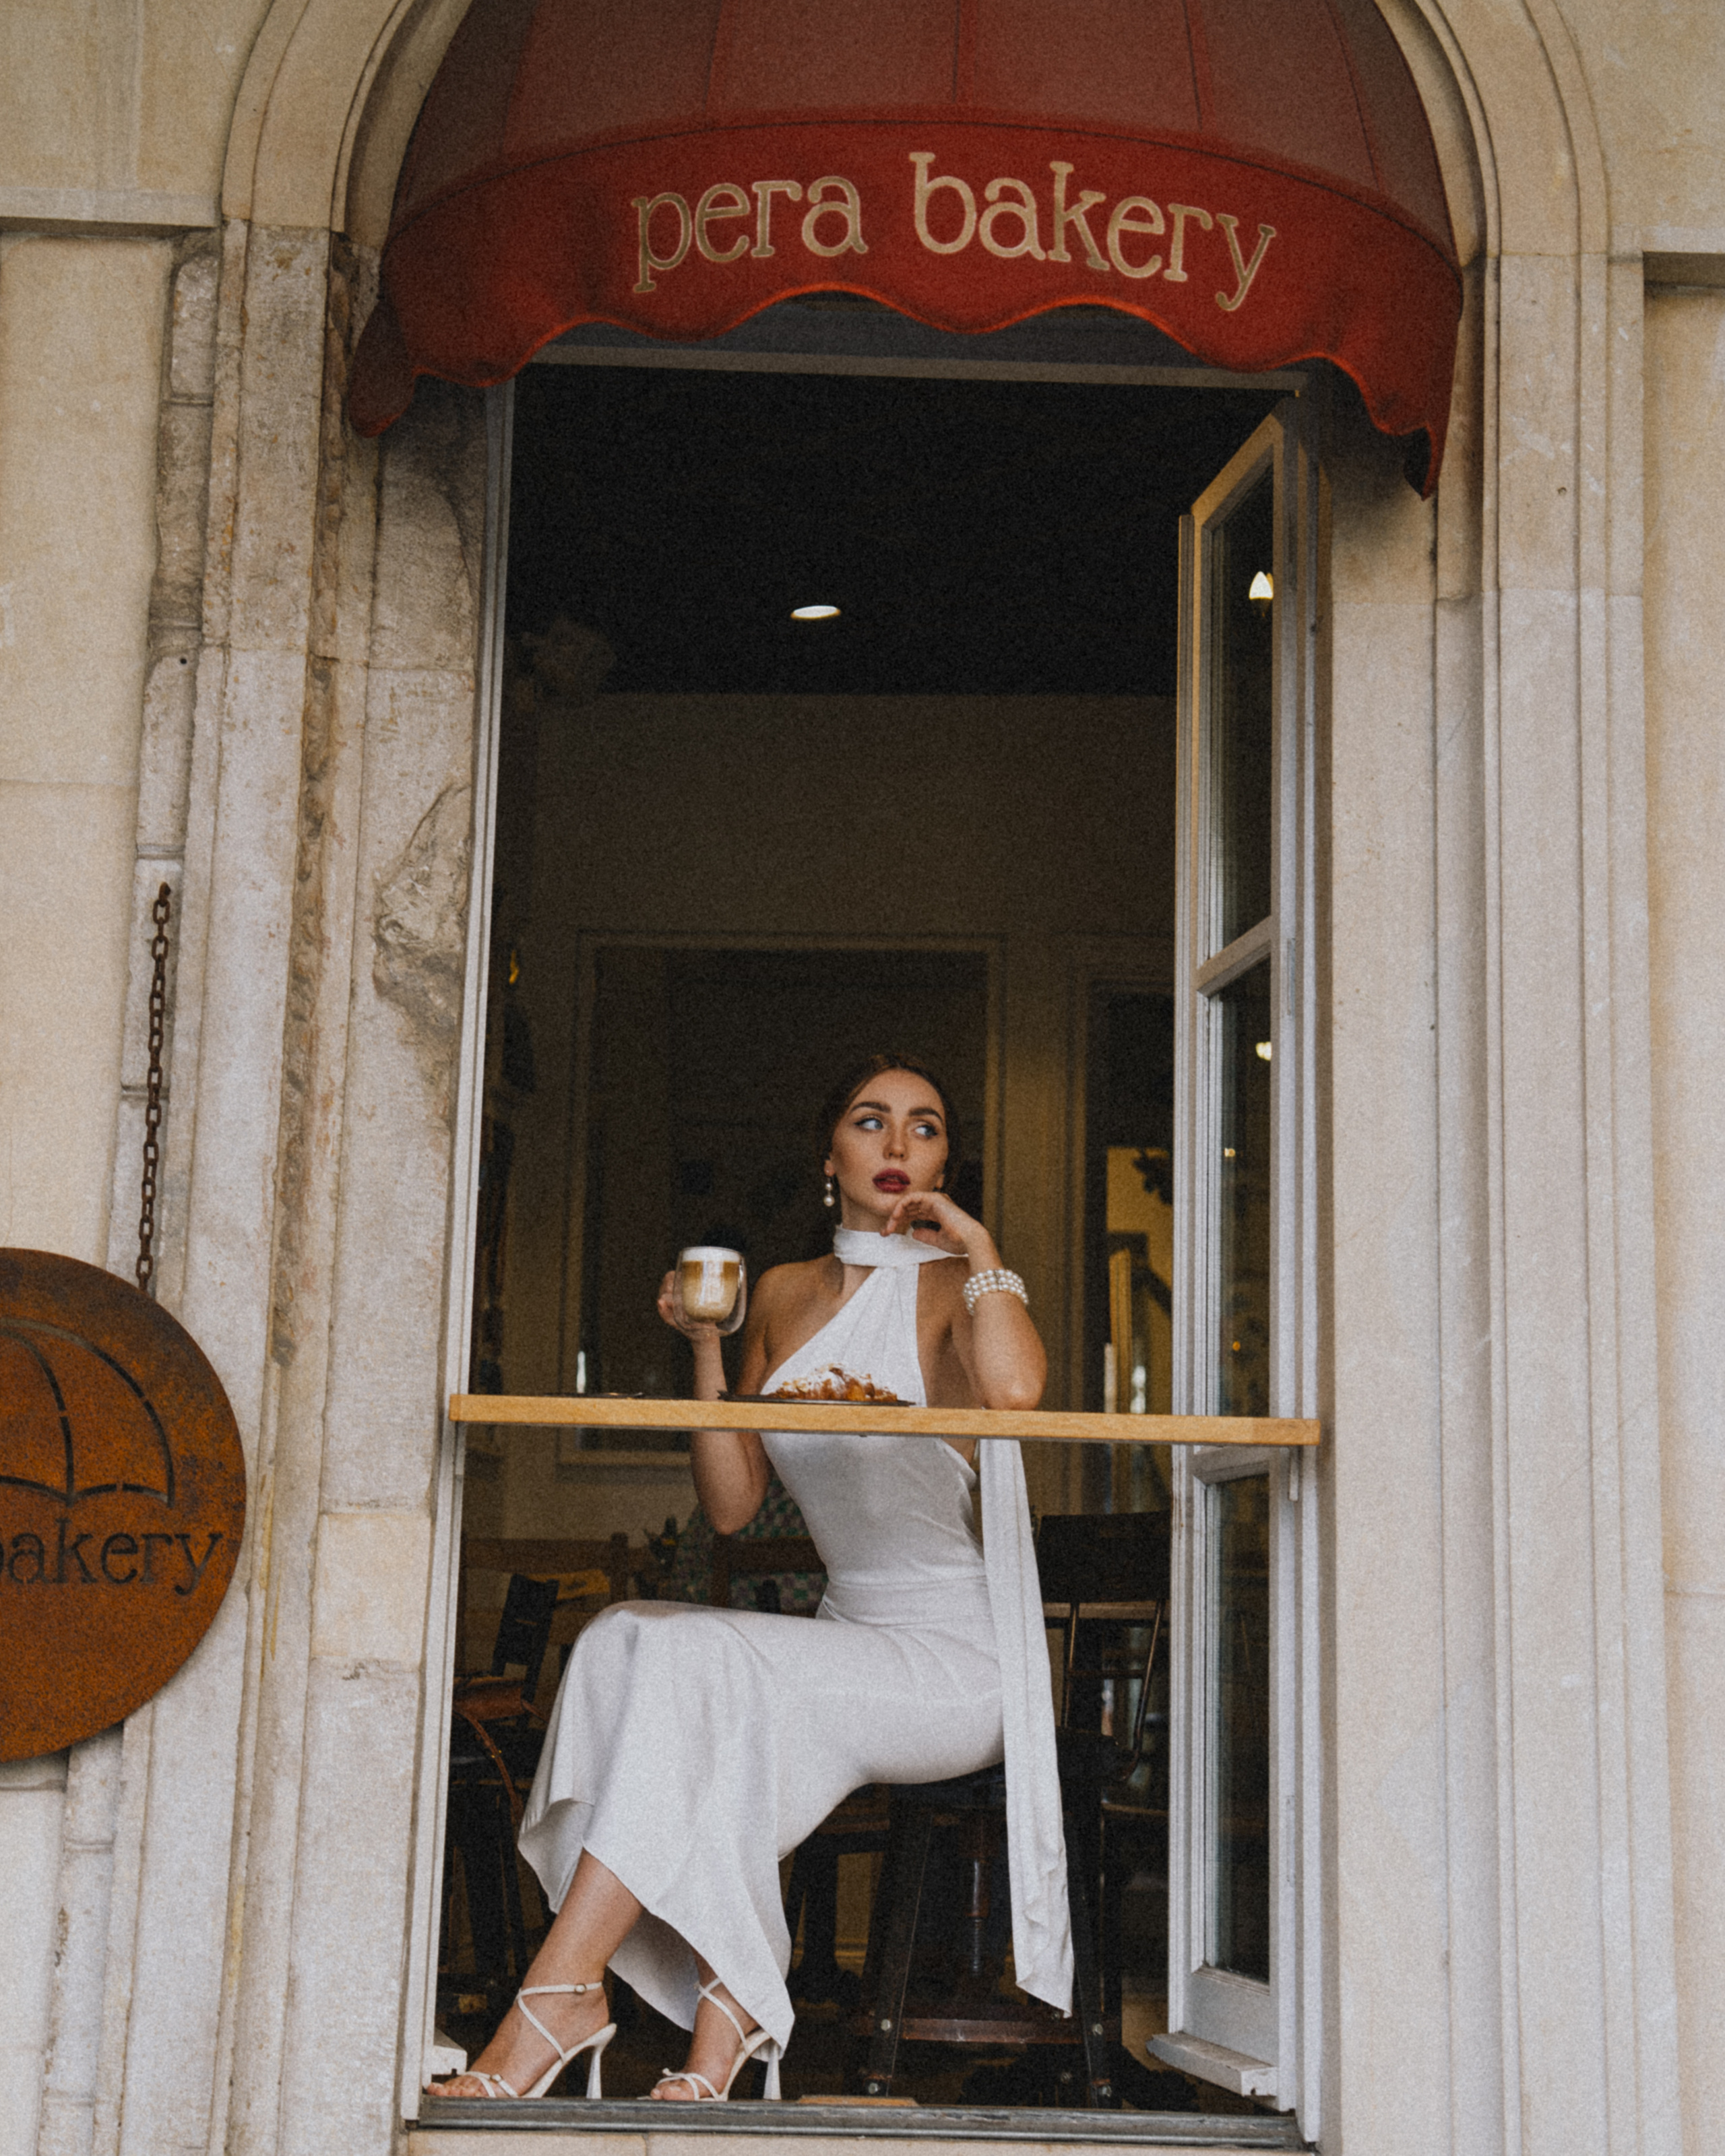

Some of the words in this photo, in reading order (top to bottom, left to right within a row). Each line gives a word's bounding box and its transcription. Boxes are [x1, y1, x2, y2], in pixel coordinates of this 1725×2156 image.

[631, 175, 869, 293] pera
[909, 152, 1276, 312] bakery
[0, 1518, 223, 1595] akery
